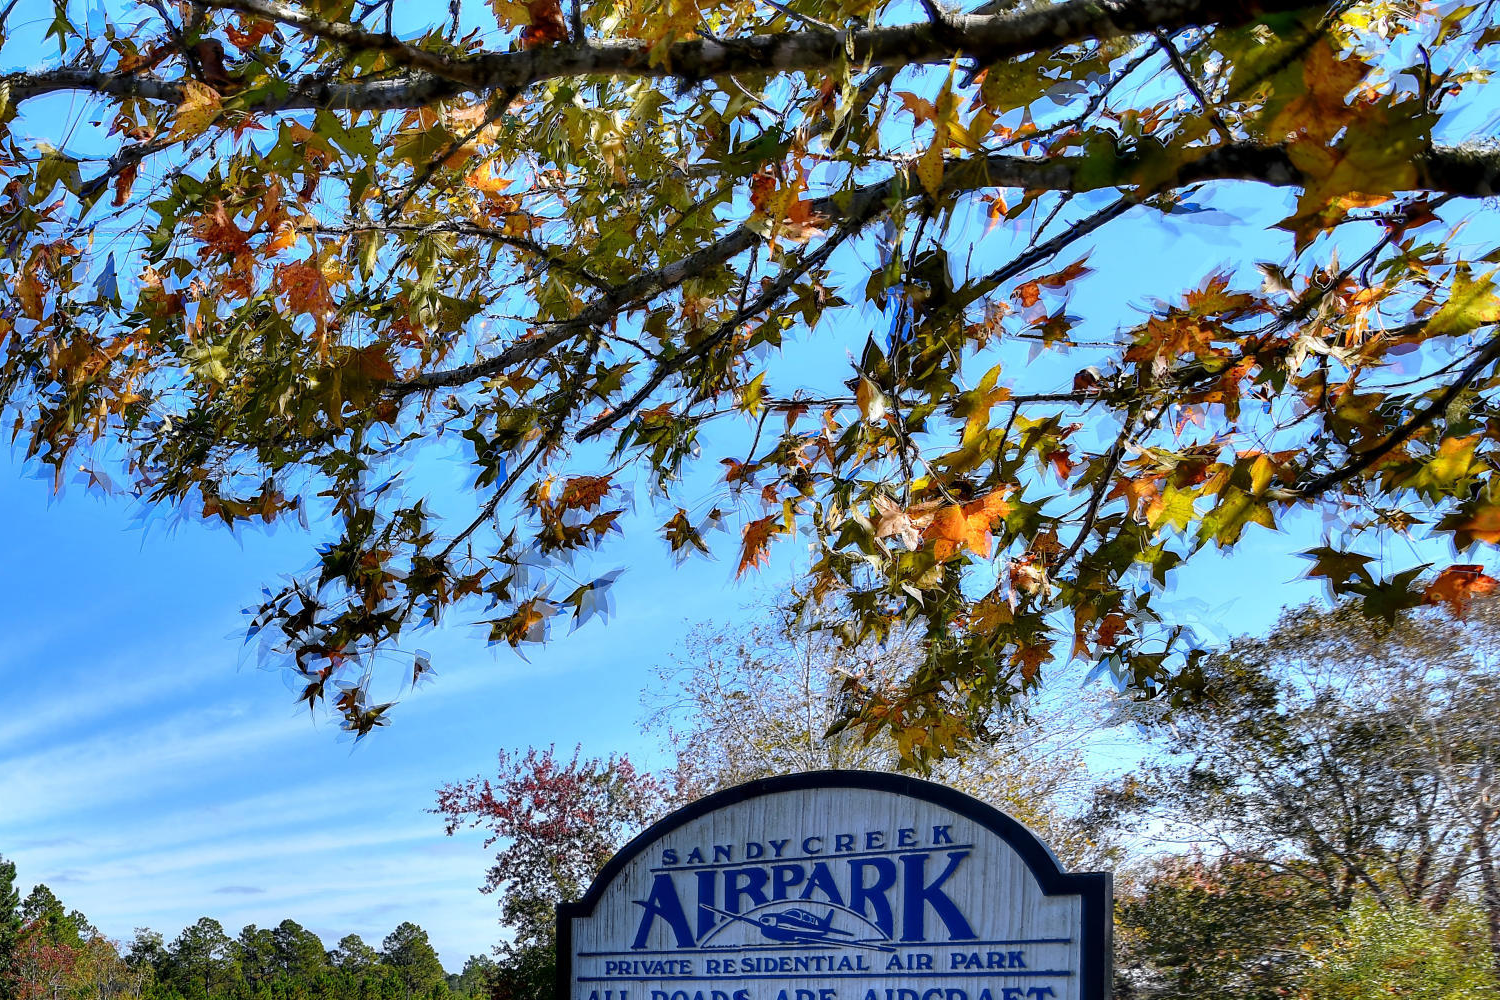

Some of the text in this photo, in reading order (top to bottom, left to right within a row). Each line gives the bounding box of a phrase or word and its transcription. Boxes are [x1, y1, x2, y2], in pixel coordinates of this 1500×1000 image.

[662, 826, 955, 865] SANDY CREEK
[631, 851, 977, 949] AIRPARK
[606, 951, 1027, 975] PRIVATE RESIDENTIAL AIR PARK
